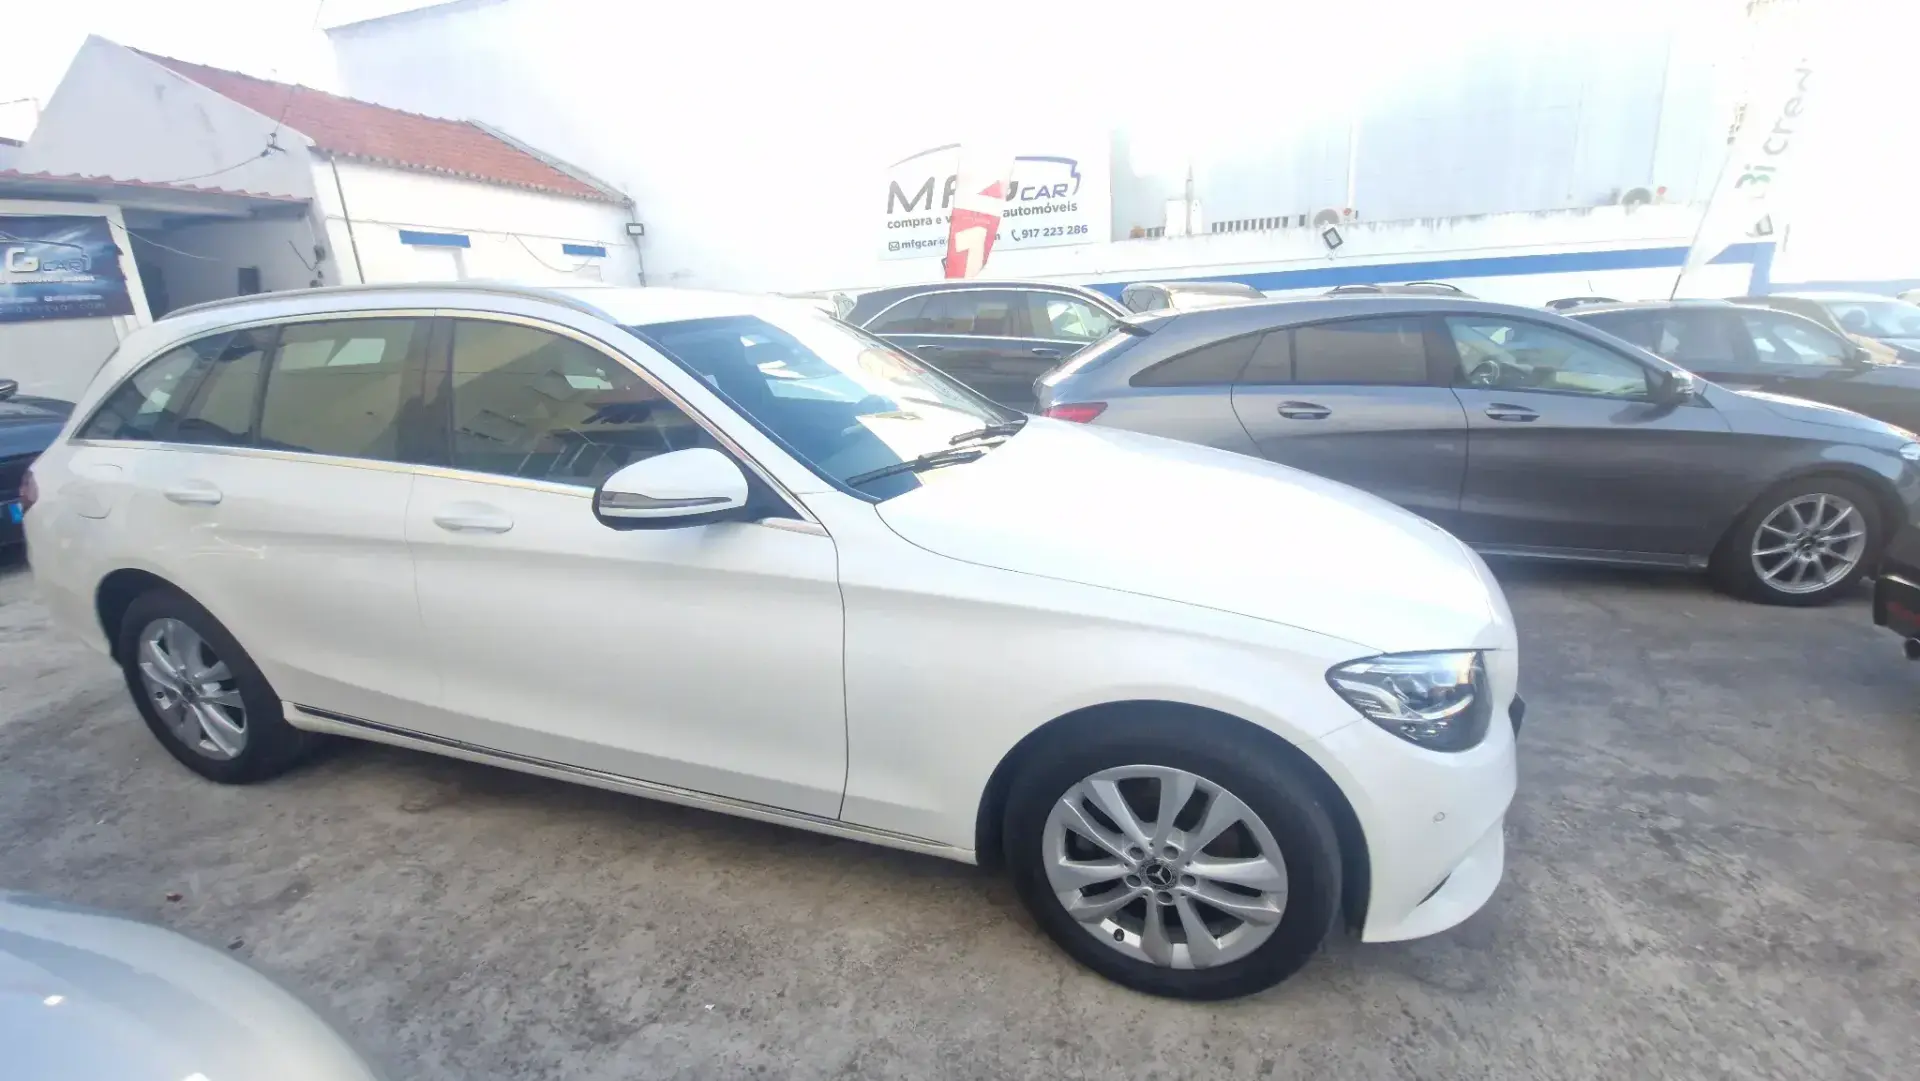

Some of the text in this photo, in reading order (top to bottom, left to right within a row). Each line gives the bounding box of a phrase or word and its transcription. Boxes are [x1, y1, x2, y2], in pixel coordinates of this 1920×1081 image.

[1021, 183, 1069, 201] CAR
[1003, 201, 1078, 218] automóveis
[887, 215, 933, 230] compra
[936, 217, 942, 225] e
[1021, 224, 1089, 240] 917 223 286
